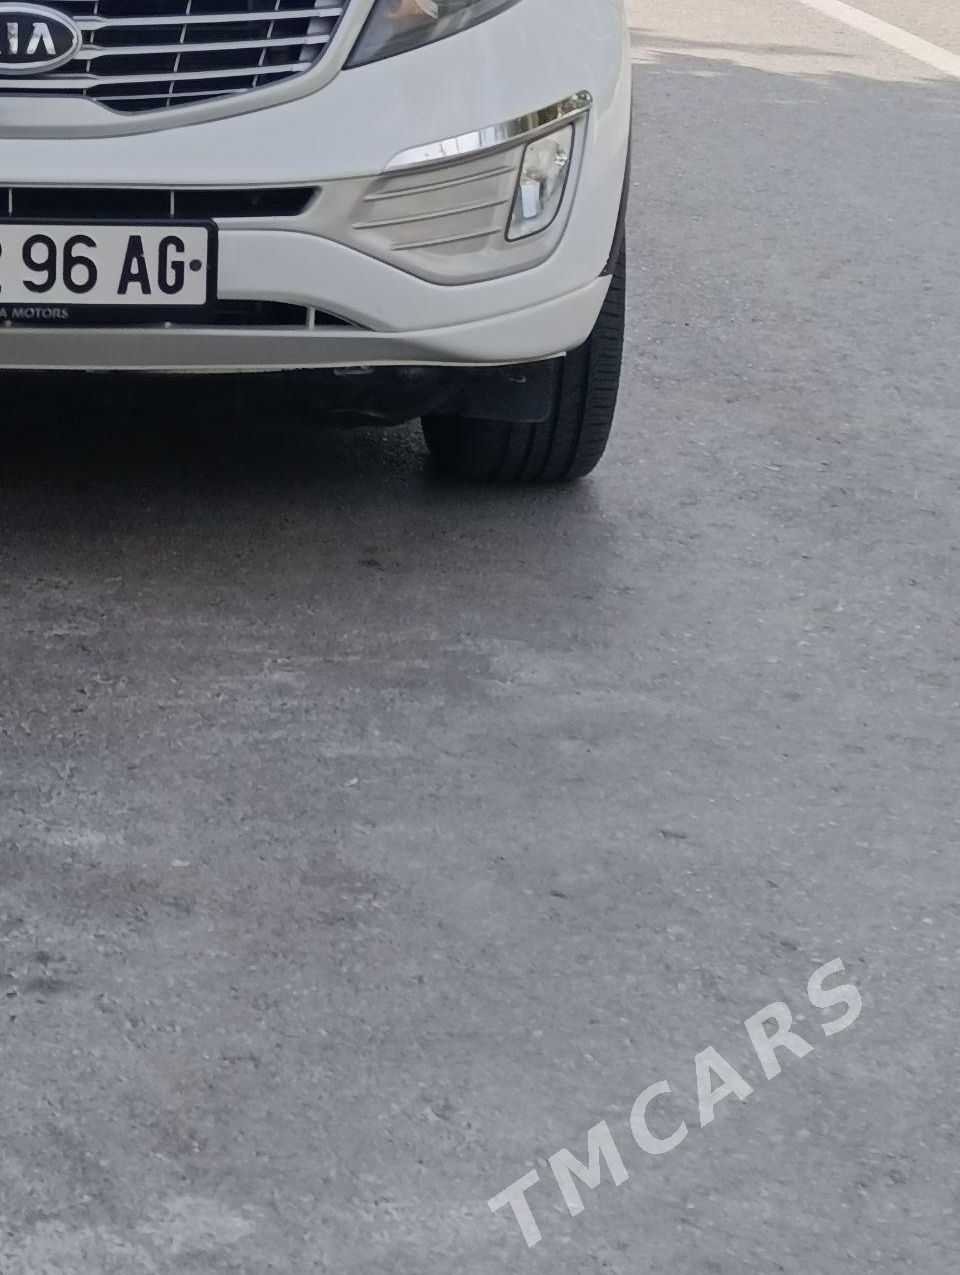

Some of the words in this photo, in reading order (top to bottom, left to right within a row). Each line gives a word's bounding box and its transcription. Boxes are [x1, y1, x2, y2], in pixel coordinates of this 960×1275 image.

[22, 234, 98, 294] 96
[117, 235, 185, 295] AG
[11, 307, 69, 319] MOTORS
